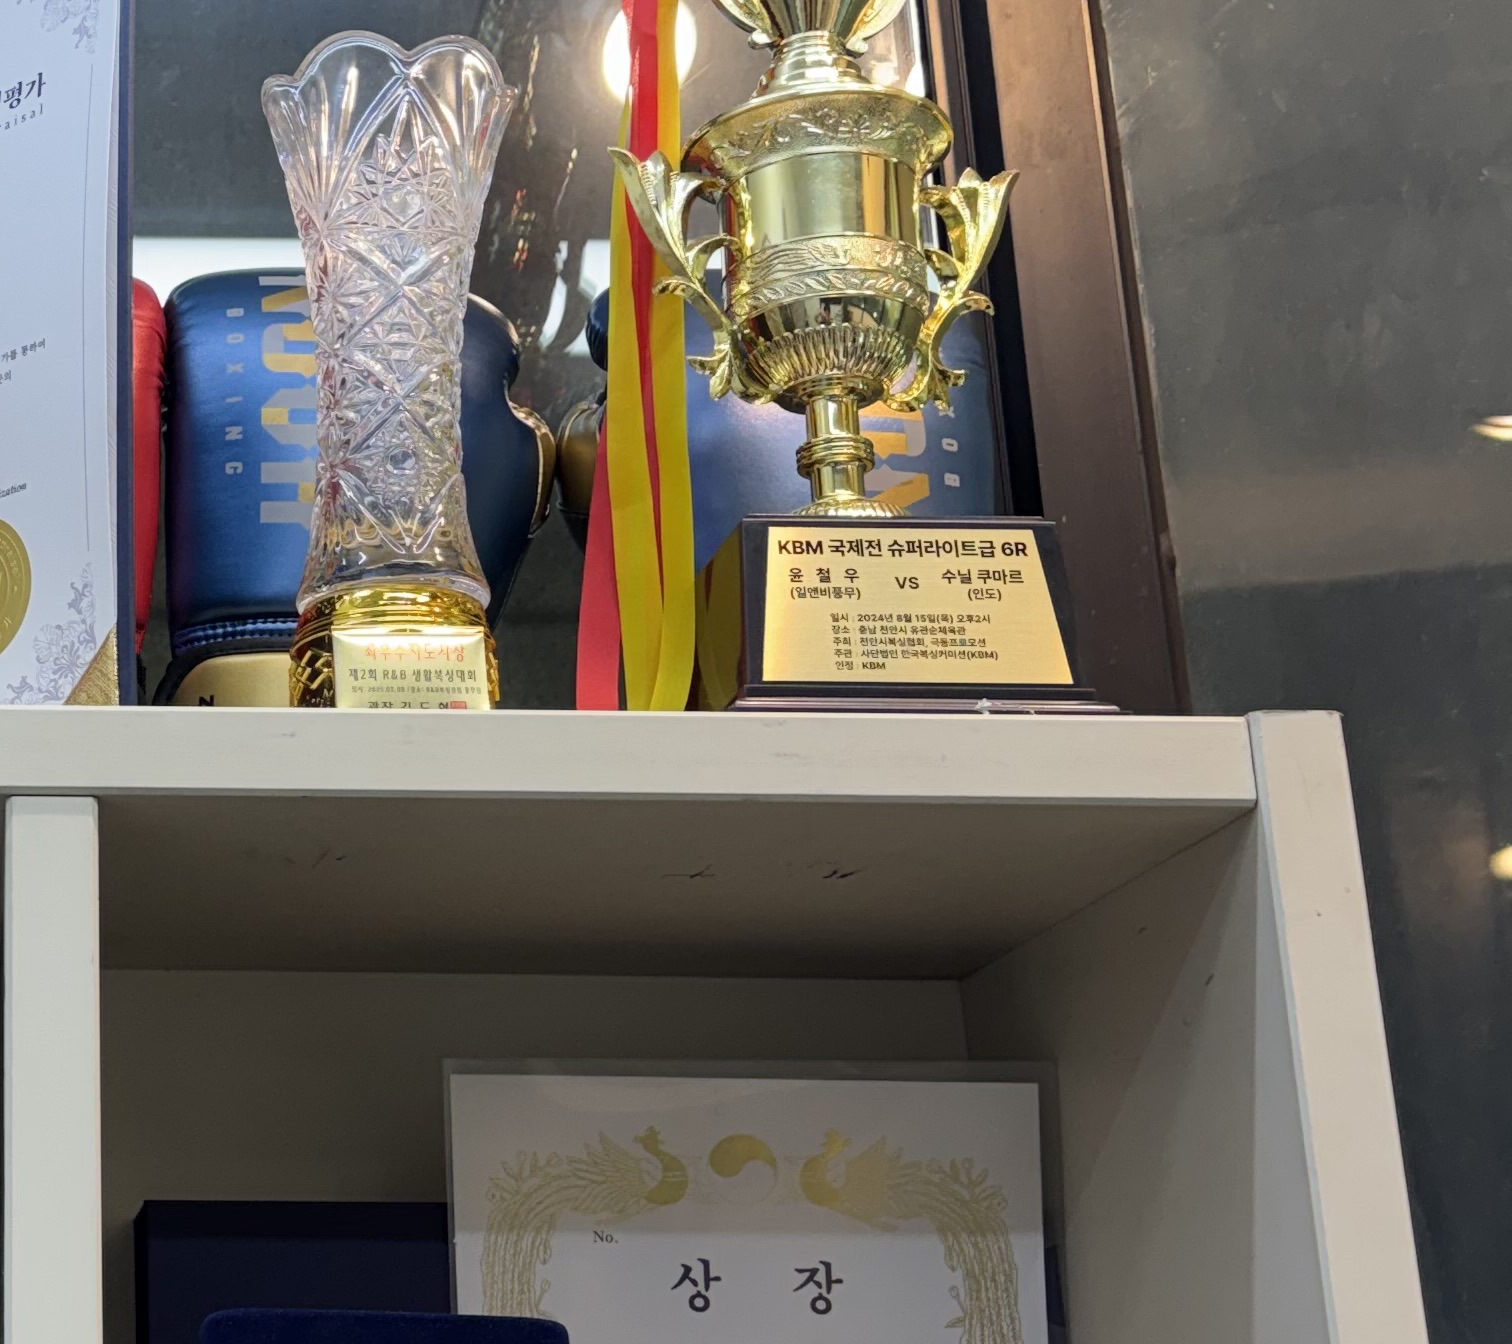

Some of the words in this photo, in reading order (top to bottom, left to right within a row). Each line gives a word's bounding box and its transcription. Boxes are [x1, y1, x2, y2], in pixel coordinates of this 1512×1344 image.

[777, 539, 824, 556] KBM
[828, 539, 883, 558] 국제전
[887, 539, 996, 559] 슈퍼라이트급
[1000, 540, 1028, 557] 6R
[789, 567, 805, 583] 윤
[816, 567, 832, 583] 철
[844, 567, 860, 583] 우
[895, 576, 920, 590] VS
[941, 568, 973, 585] 수닐
[977, 568, 1024, 585] 쿠마르
[967, 587, 1002, 601] (인도)
[862, 661, 886, 670] KBM
[349, 668, 377, 682] 제2회
[383, 669, 407, 680] R&B
[593, 1230, 619, 1244] No.
[670, 1258, 722, 1313] 상
[792, 1260, 844, 1315] 장
